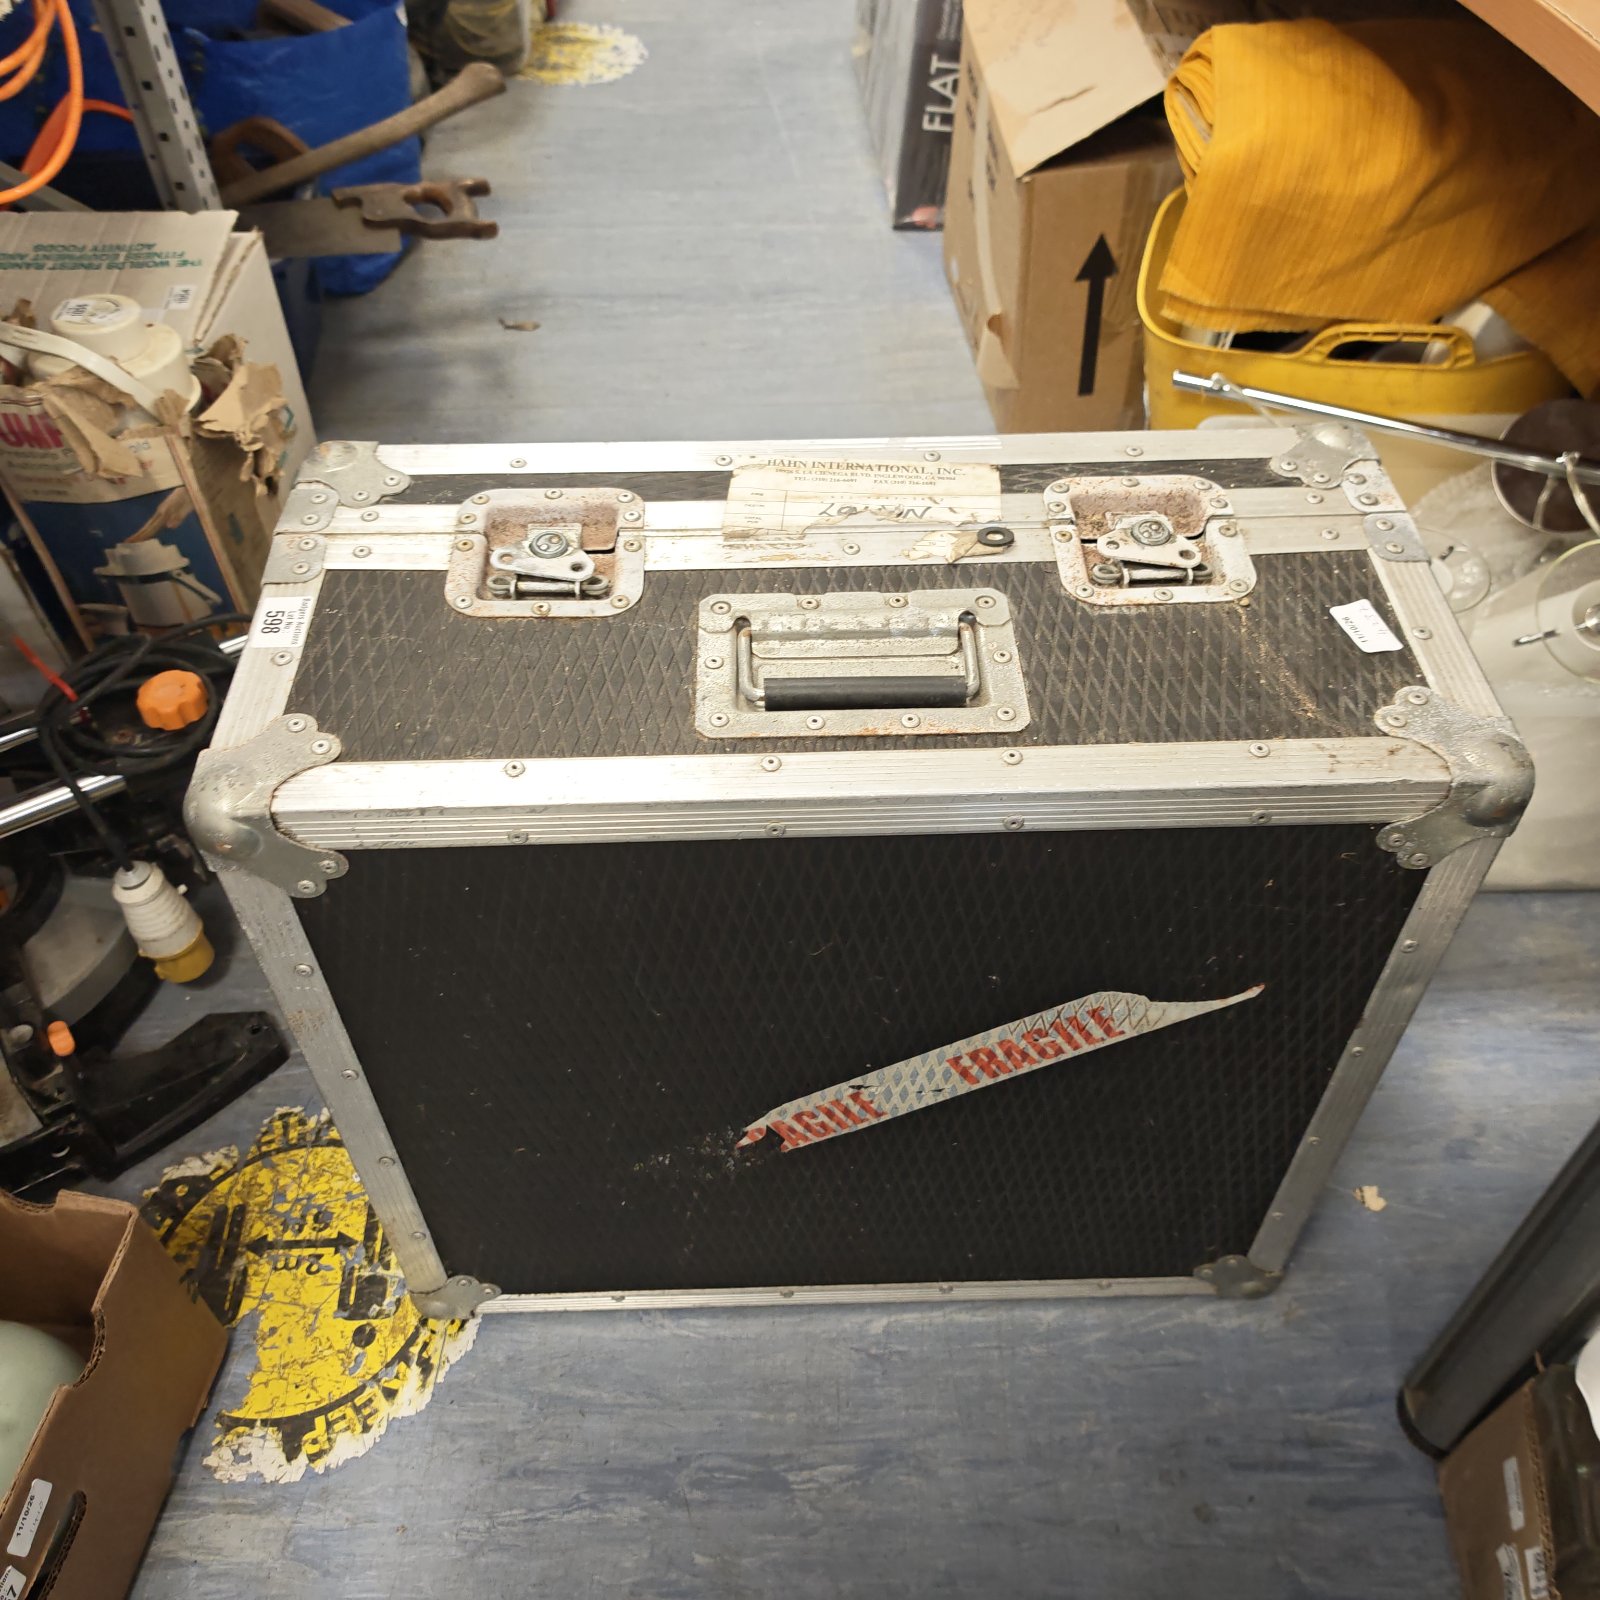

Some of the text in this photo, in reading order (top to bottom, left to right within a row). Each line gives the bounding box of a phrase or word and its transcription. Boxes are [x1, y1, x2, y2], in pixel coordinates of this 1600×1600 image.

[922, 54, 960, 132] FLAT
[767, 459, 967, 476] HAHN INTERNATIONAL, INC.
[261, 610, 285, 634] 598
[946, 1006, 1126, 1086] FRAGILE
[16, 1494, 35, 1537] 11/10/26
